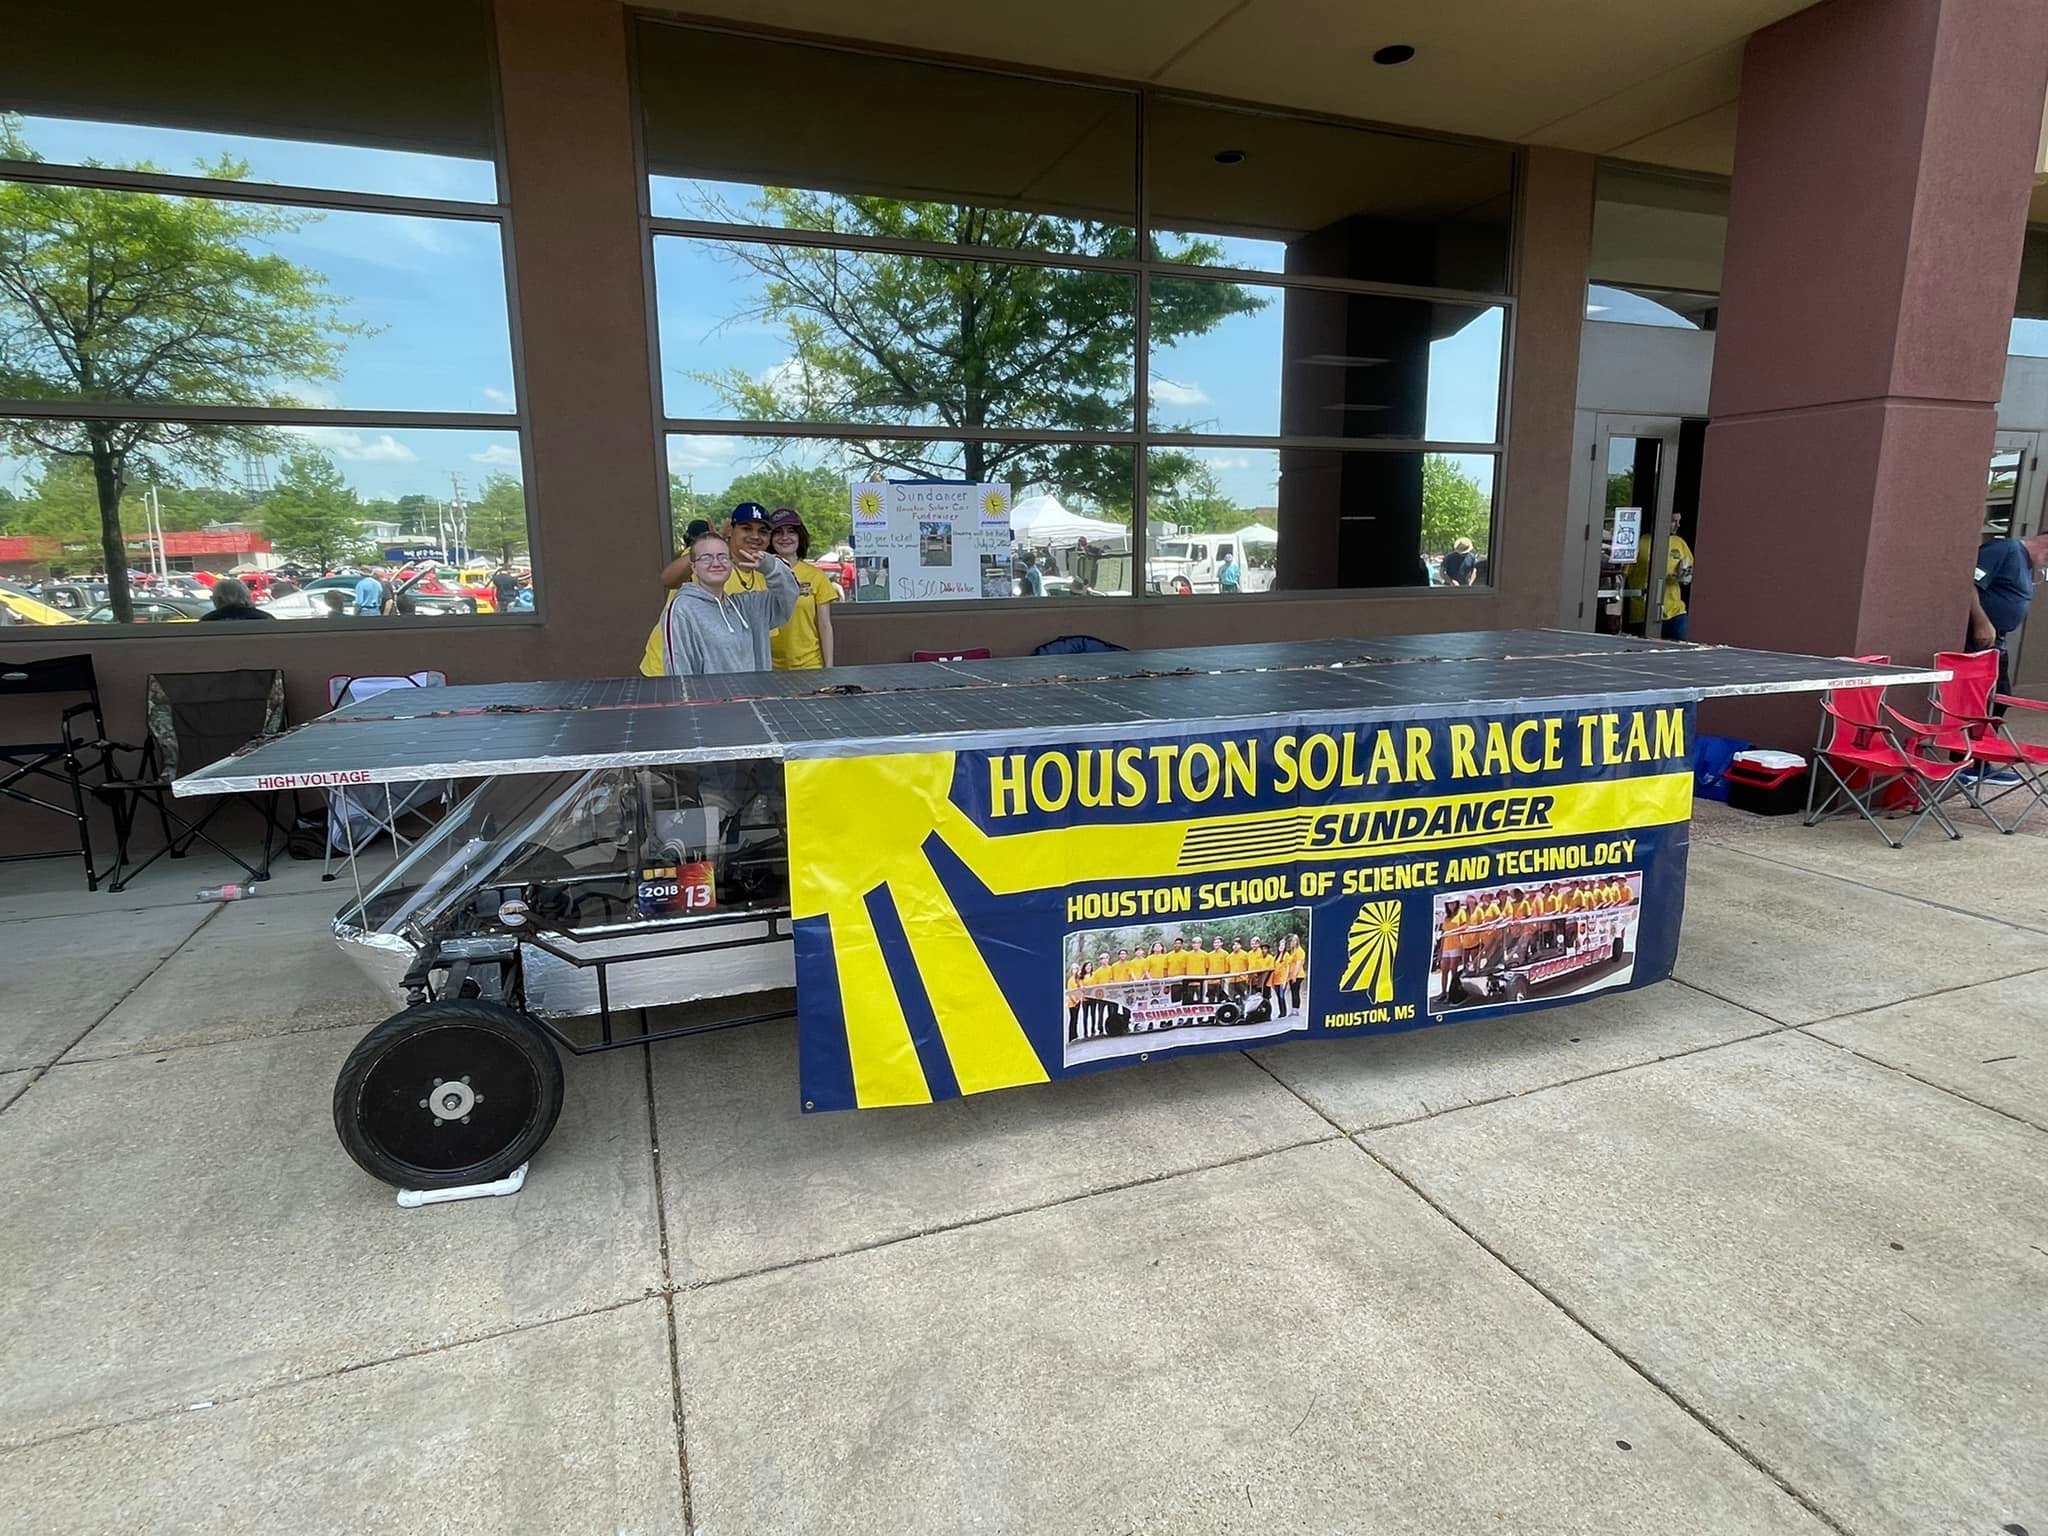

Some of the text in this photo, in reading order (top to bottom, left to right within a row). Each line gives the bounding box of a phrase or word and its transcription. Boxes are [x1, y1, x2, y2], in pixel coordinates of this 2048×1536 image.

[896, 485, 968, 501] Sundancer
[752, 506, 762, 519] LA
[912, 512, 960, 520] Fundraiser
[988, 708, 1685, 818] HOUSTON SOLAR RACE TEAM
[257, 771, 371, 789] HIGH VOLTAGE
[1311, 795, 1554, 847] SUNDANCER
[1067, 839, 1637, 923] HOUSTON SCHOOL OF SCIENCE AND TECHNOLOGY
[644, 885, 679, 898] 2018
[685, 884, 711, 907] 13
[1324, 1002, 1415, 1028] HOUSTON, MS
